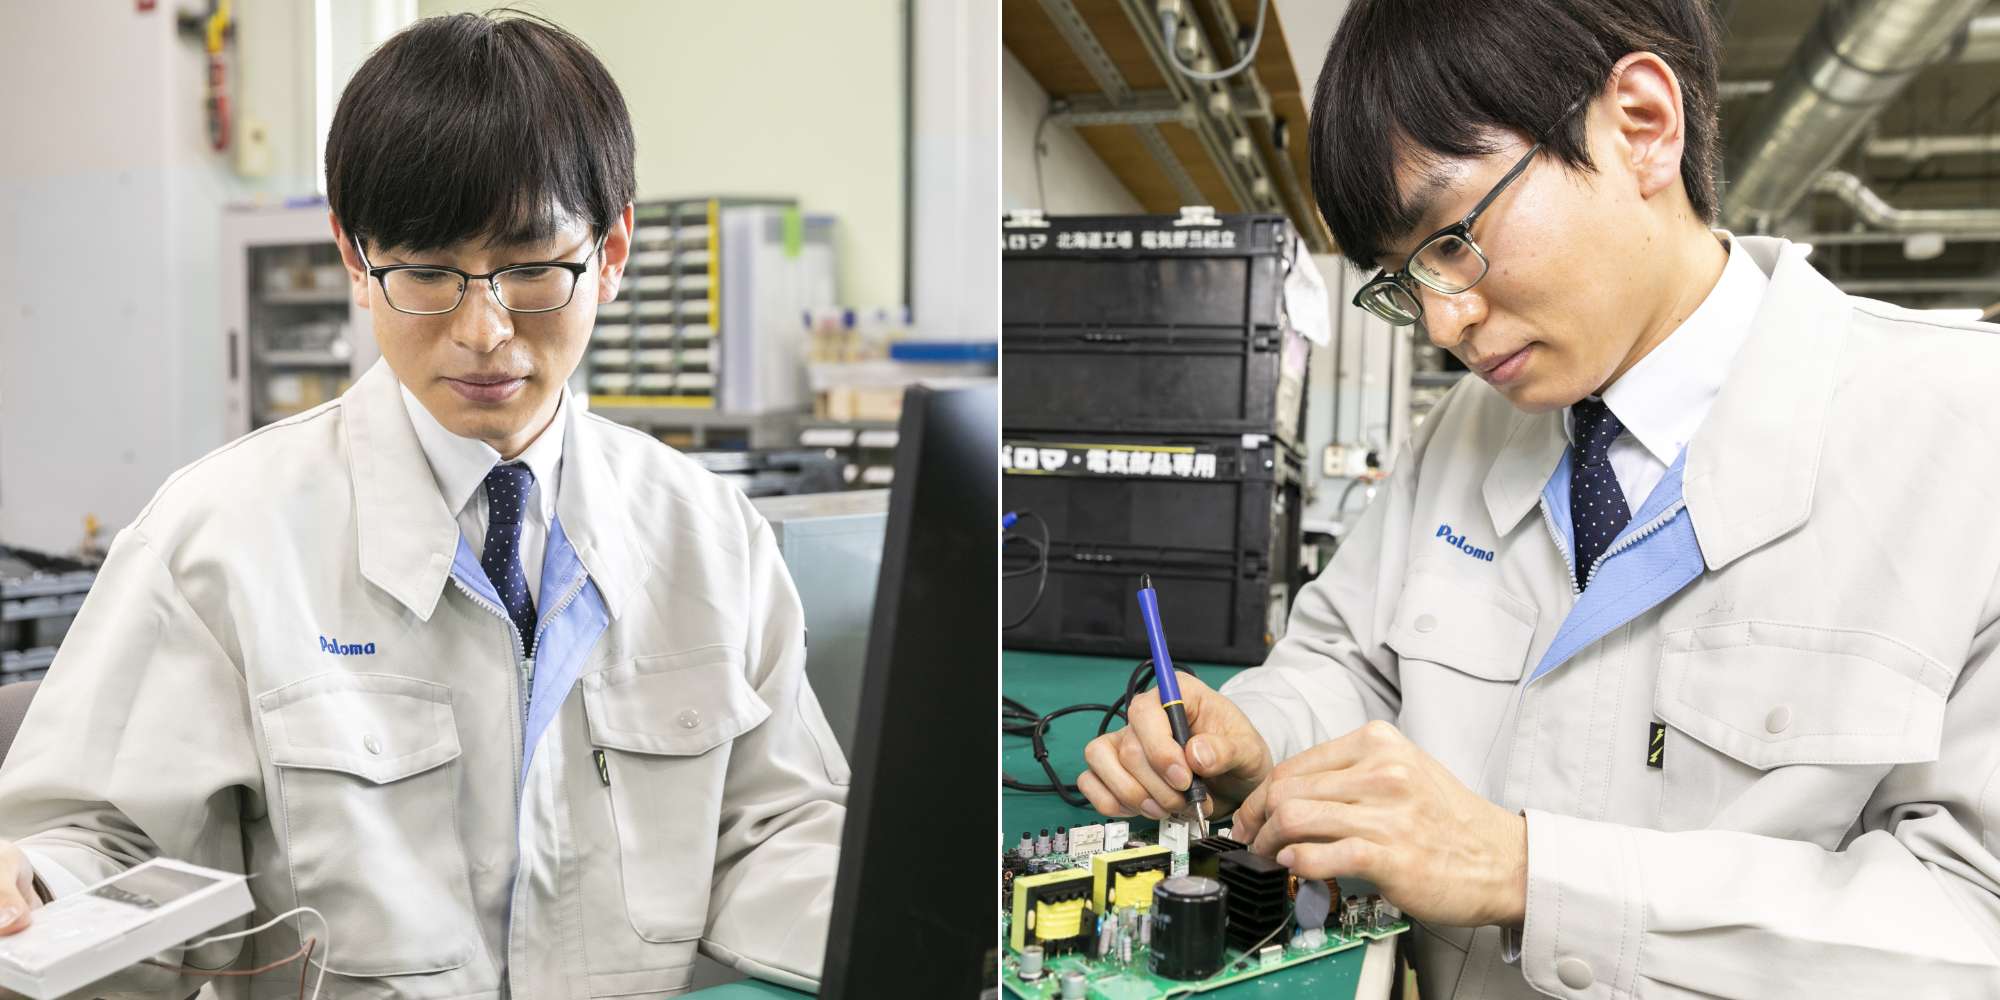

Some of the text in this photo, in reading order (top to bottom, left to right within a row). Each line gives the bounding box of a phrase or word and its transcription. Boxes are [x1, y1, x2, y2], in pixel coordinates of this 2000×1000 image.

[1002, 230, 1236, 250] ロマ 北海道工場 電気部品組立
[1436, 524, 1494, 562] Paloma
[319, 635, 376, 656] Paloma
